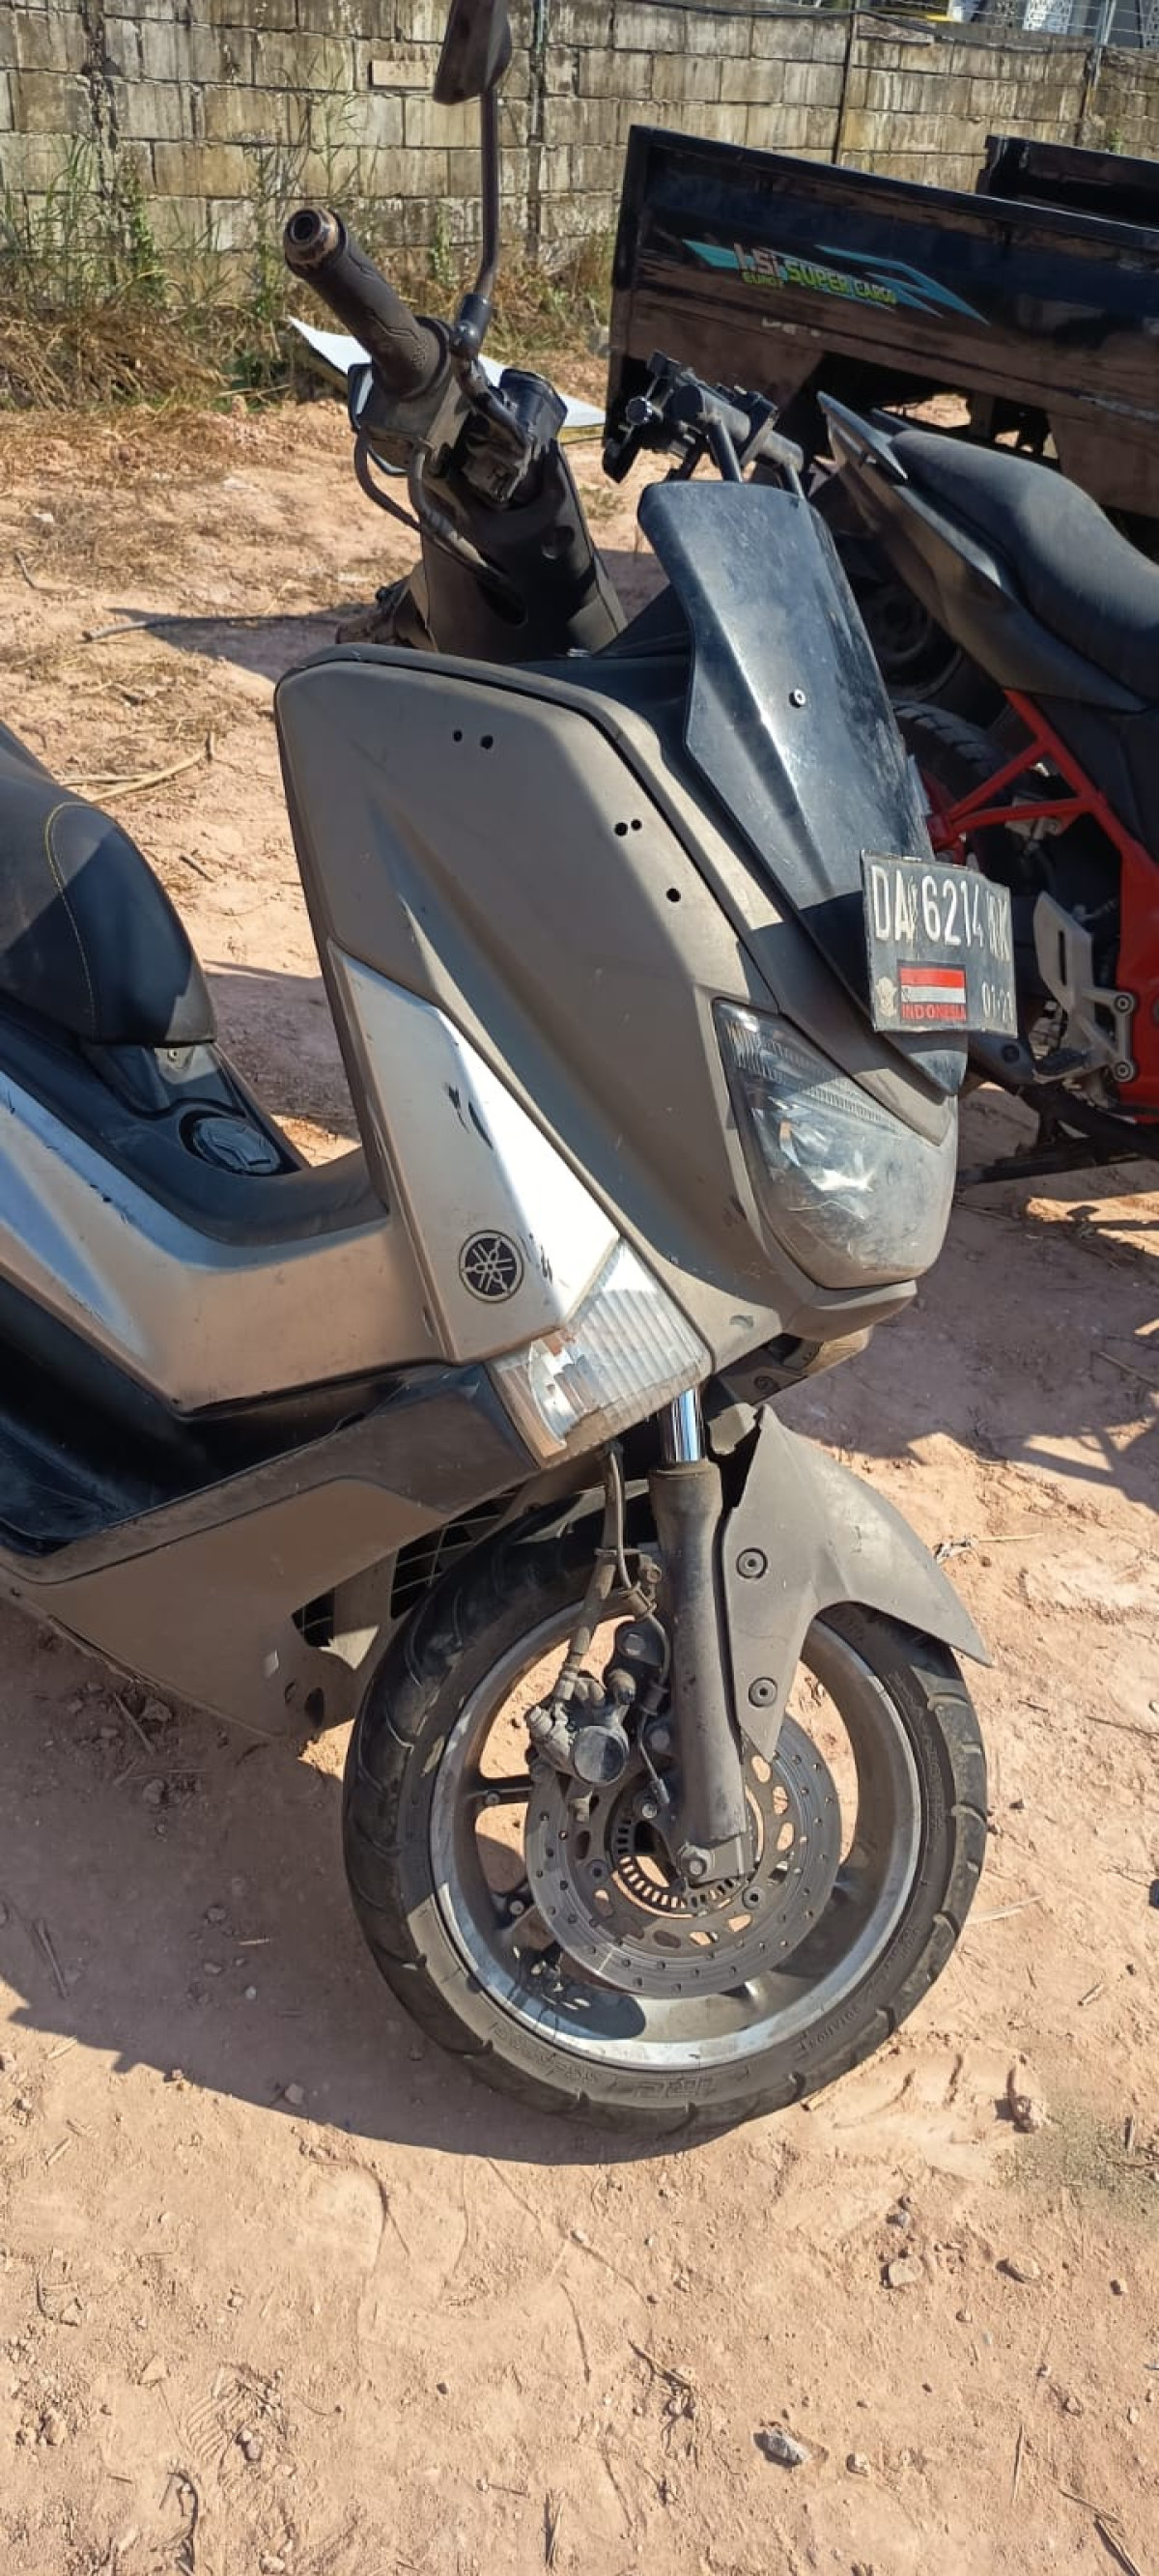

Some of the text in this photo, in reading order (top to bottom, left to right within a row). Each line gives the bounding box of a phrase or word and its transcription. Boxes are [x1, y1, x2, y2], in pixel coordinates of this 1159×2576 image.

[784, 260, 849, 294] SUPER
[871, 865, 912, 942] DA
[922, 875, 984, 948] 6214
